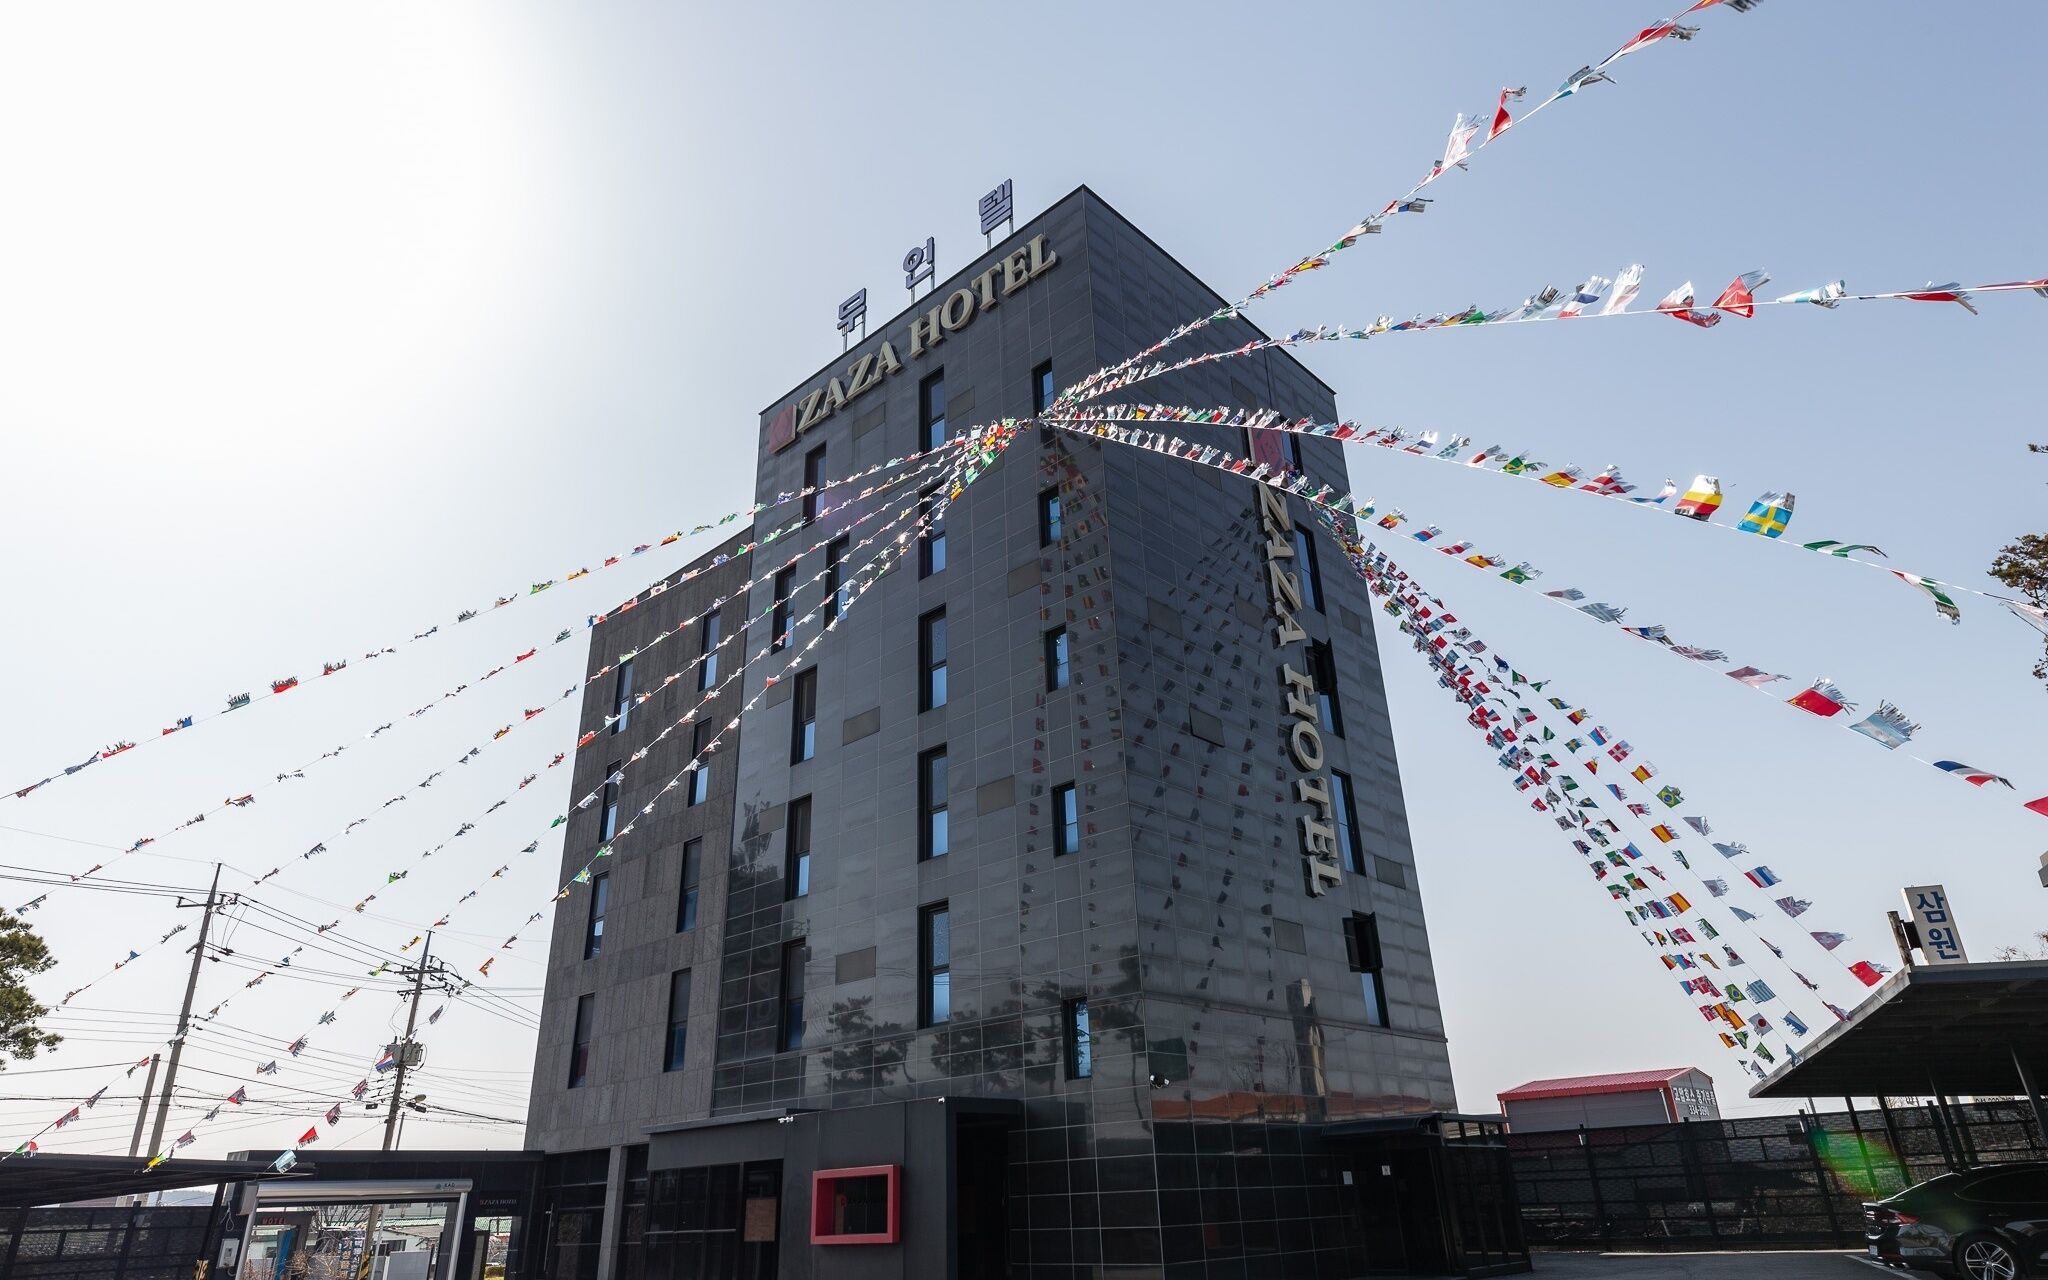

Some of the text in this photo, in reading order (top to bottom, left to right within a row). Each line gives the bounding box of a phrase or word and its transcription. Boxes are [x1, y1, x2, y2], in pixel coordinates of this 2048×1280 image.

[797, 234, 1057, 434] ZAZA HOTEL
[837, 178, 1013, 332] 무인텔
[1259, 481, 1343, 897] ZAZA HOTEL
[1916, 891, 1961, 960] 삼원
